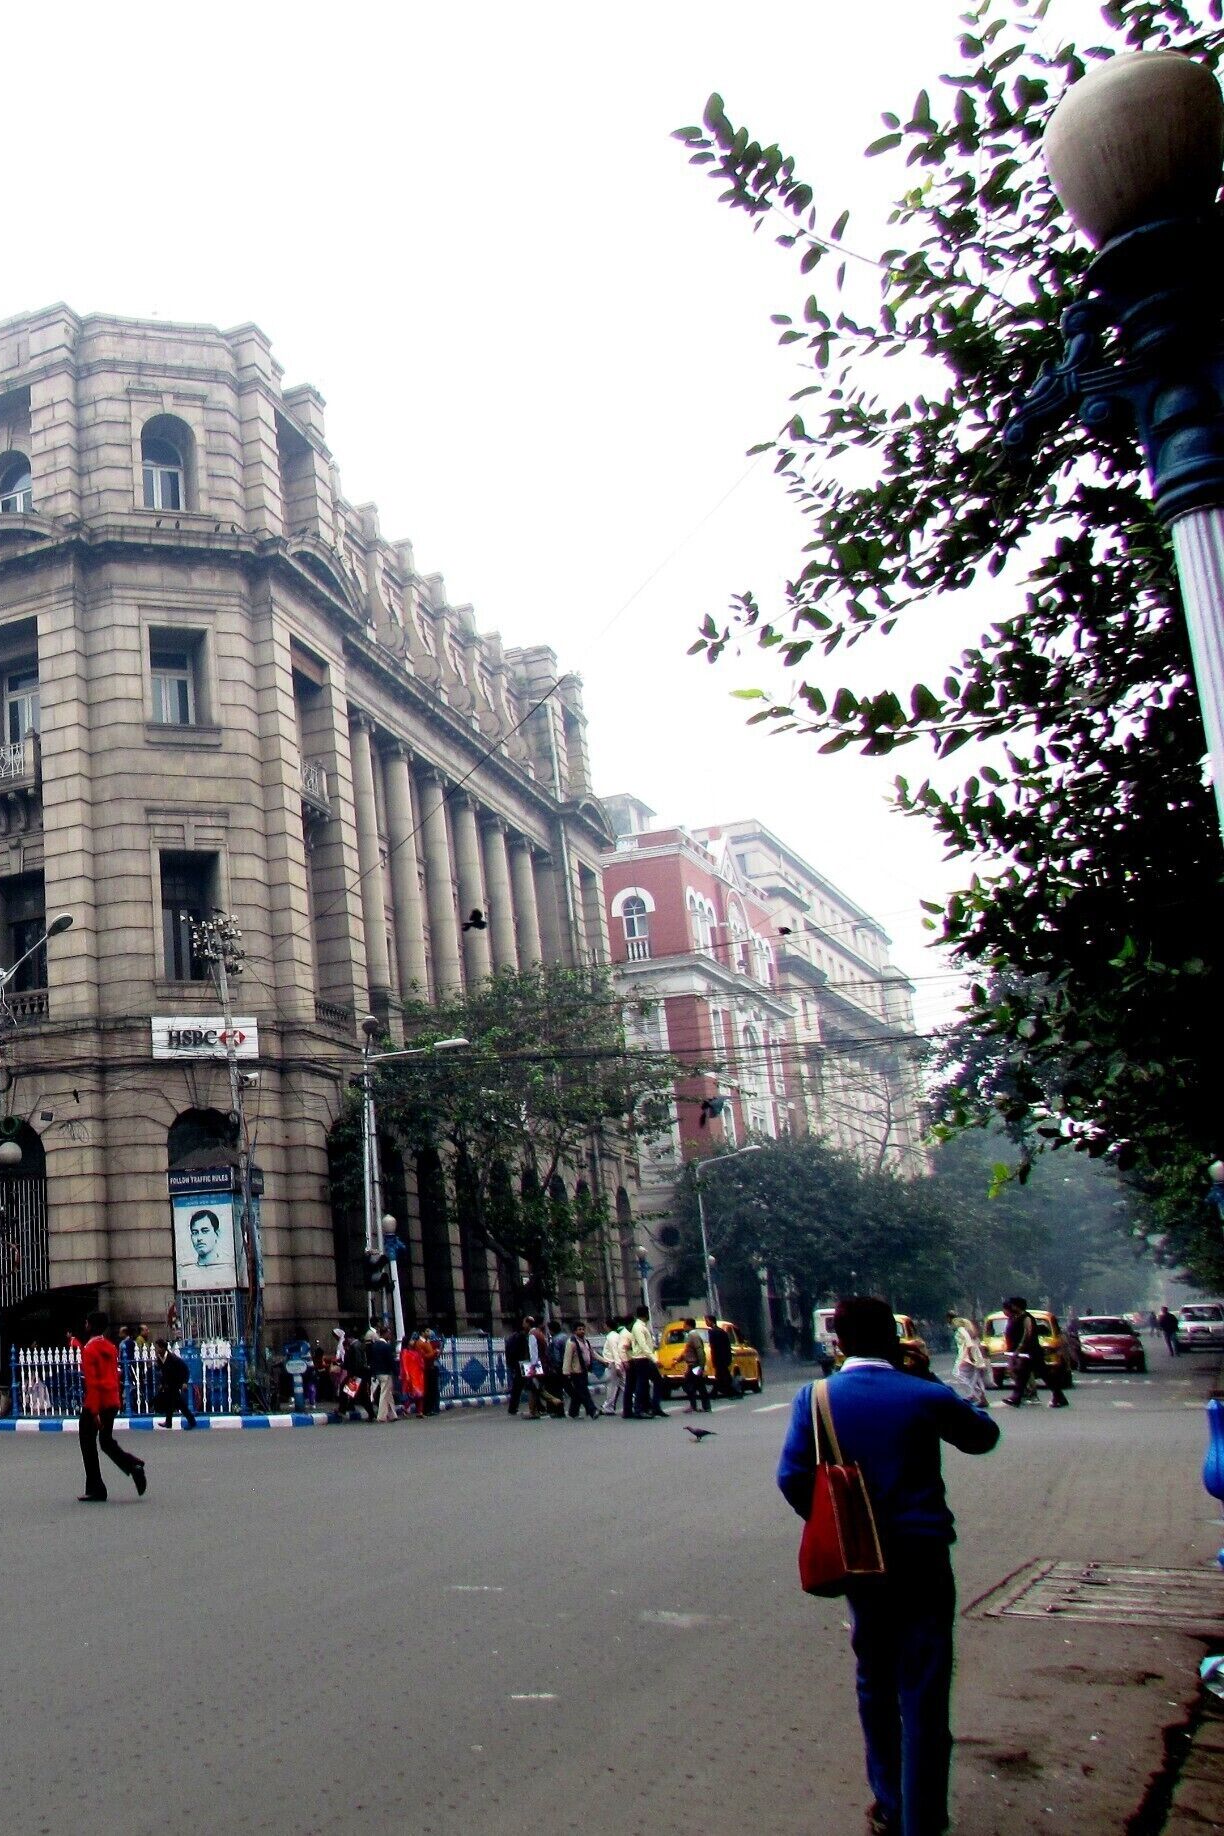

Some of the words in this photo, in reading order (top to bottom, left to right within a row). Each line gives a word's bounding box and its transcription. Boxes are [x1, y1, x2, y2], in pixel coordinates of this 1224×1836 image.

[168, 1029, 217, 1046] HSBC
[169, 1176, 190, 1185] FOLLOW
[190, 1175, 211, 1183] TRAFFIC
[211, 1174, 228, 1182] RULES
